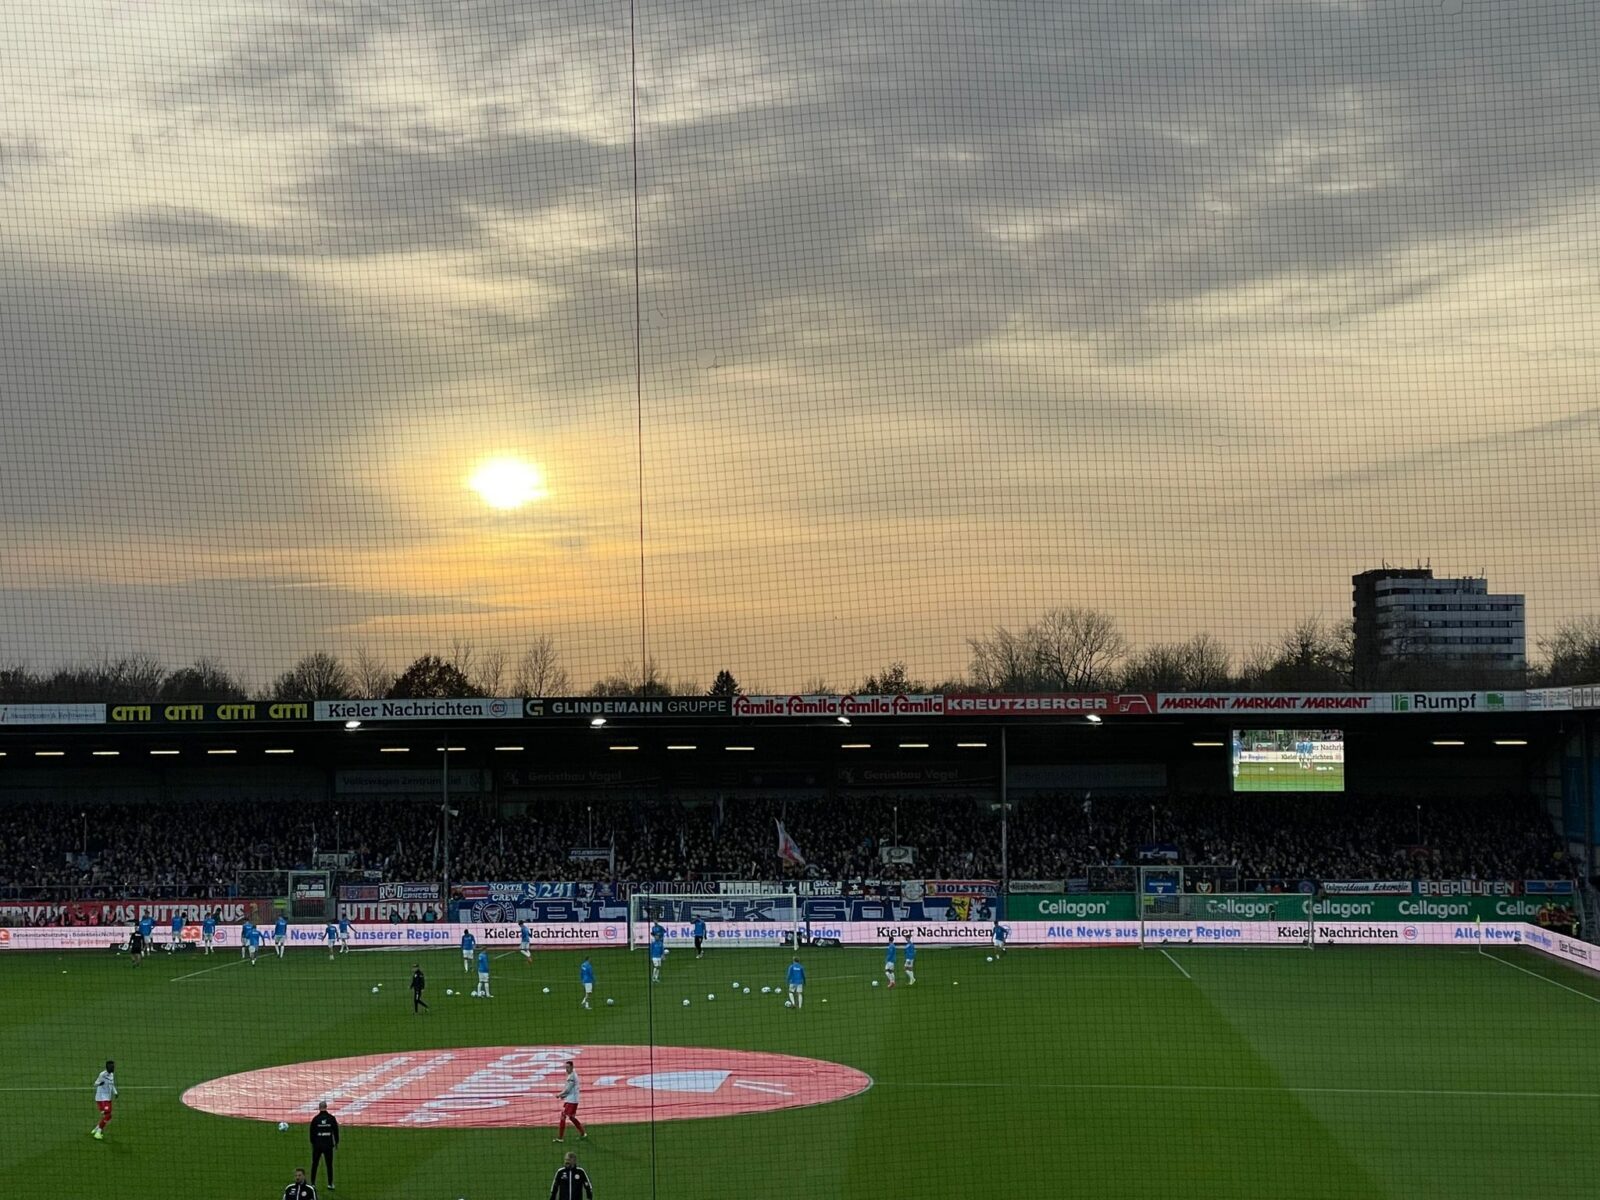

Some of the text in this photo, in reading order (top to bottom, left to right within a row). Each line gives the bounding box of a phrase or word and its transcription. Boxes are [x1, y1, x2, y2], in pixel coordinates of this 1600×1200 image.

[552, 701, 727, 713] GLINDEMANN GRUPPE
[733, 695, 784, 714] famila
[787, 695, 837, 714] famila
[838, 695, 890, 714] famila
[892, 695, 943, 714] famila
[947, 698, 1107, 710] KREUTZBERGER
[1160, 698, 1229, 708] MARKANT
[1231, 698, 1300, 708] MARKANT
[1301, 697, 1372, 708] MARKANT
[1413, 693, 1476, 711] Rumpf
[329, 702, 483, 717] Kieler Nachrichten
[489, 883, 523, 891] NORTH
[291, 930, 323, 940] News
[354, 931, 402, 939] unserer
[407, 929, 449, 941] Region
[484, 928, 522, 938] Kieler
[681, 928, 715, 938] Nes
[877, 928, 993, 938] Kieler Nachrichten
[1048, 927, 1241, 939] Alle News aus unserer Region
[1320, 927, 1398, 938] Nachrichten
[1455, 928, 1521, 939] Alle News
